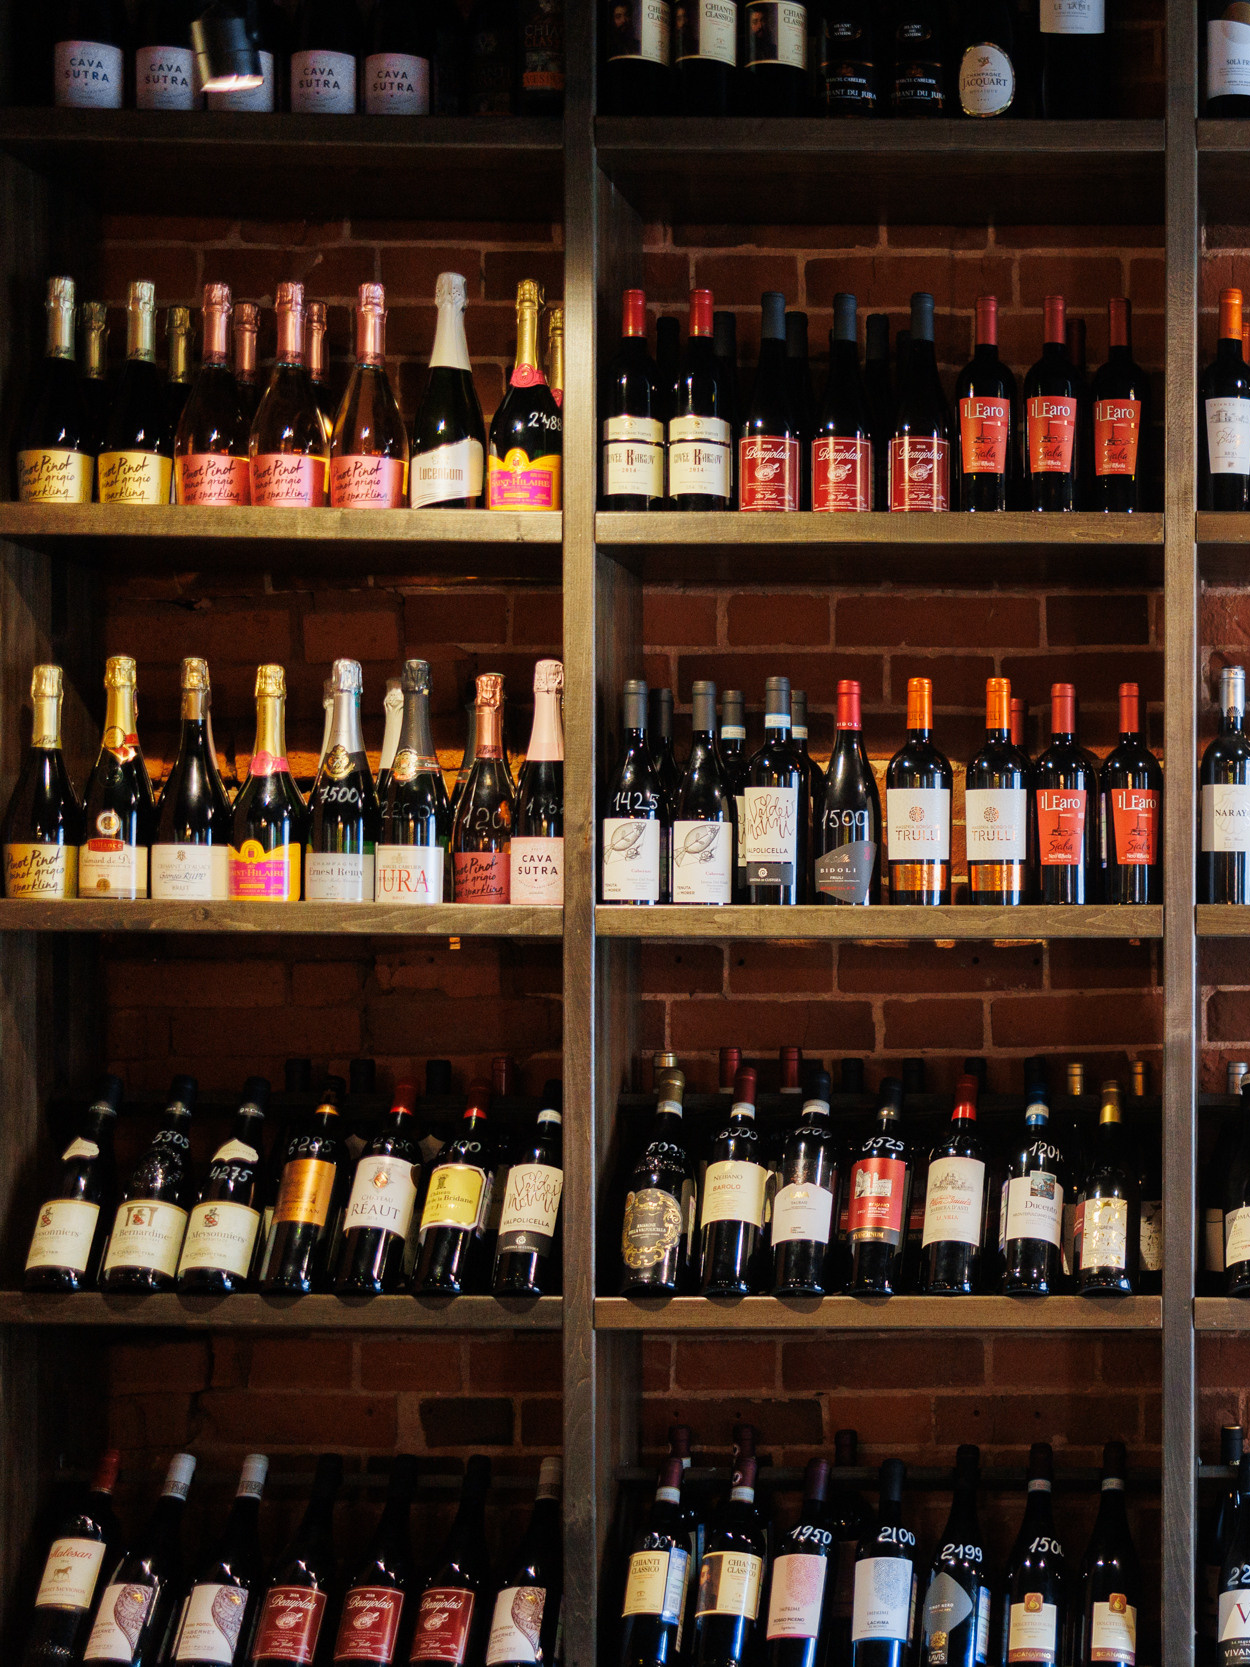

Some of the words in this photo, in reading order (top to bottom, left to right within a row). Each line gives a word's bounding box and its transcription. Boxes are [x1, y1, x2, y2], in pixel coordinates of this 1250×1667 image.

[69, 58, 104, 70] CAVA
[150, 63, 182, 74] CAVA
[65, 70, 110, 83] SUTRA
[303, 68, 335, 78] CAVA
[377, 70, 408, 79] CAVA
[145, 74, 189, 87] SUTRA
[299, 79, 341, 90] SUTRA
[373, 81, 414, 92] SUTRA
[962, 78, 1008, 91] JACQUART
[744, 446, 791, 463] Beaujolais
[818, 447, 863, 463] Beaujolais
[897, 446, 944, 463] Beaujolais
[41, 455, 73, 475] Pinot
[118, 457, 150, 475] Pinot
[205, 459, 237, 479] Pinot
[275, 459, 306, 478] Pinot
[352, 460, 383, 478] Pinot
[25, 486, 70, 502] sparkling
[613, 791, 660, 812] 1425
[822, 808, 867, 831] 1500
[895, 829, 941, 842] TRULLI
[971, 830, 1016, 842] TRULLI
[31, 849, 64, 868] Pinot
[469, 857, 499, 874] Pinot
[522, 855, 553, 864] CAVA
[309, 867, 335, 878] Ernest
[518, 865, 559, 876] SUTRA
[13, 879, 59, 893] sparkling
[378, 869, 432, 899] JURA
[210, 1165, 254, 1183] 4275
[712, 1183, 742, 1192] BAROLO
[444, 1194, 475, 1205] Bridane
[351, 1200, 401, 1220] RÉAUT
[1024, 1200, 1058, 1216] Ducento
[119, 1230, 171, 1242] Bernardine
[191, 1230, 248, 1244] Meysonniers
[790, 1525, 834, 1545] 1950
[877, 1526, 917, 1546] 2100
[50, 1545, 94, 1560] Malesan
[940, 1543, 984, 1562] 2199
[632, 1558, 661, 1567] CHIANTI
[728, 1558, 758, 1571] CHIANTI
[631, 1567, 660, 1575] CLASSICO
[727, 1567, 757, 1578] CLASSICO
[269, 1593, 317, 1613] Beaujolais
[347, 1595, 395, 1613] Beaujolais
[422, 1596, 464, 1613] Beaujolais
[1012, 1651, 1052, 1660] SCANAVINO
[1096, 1651, 1135, 1662] SCANAVINO
